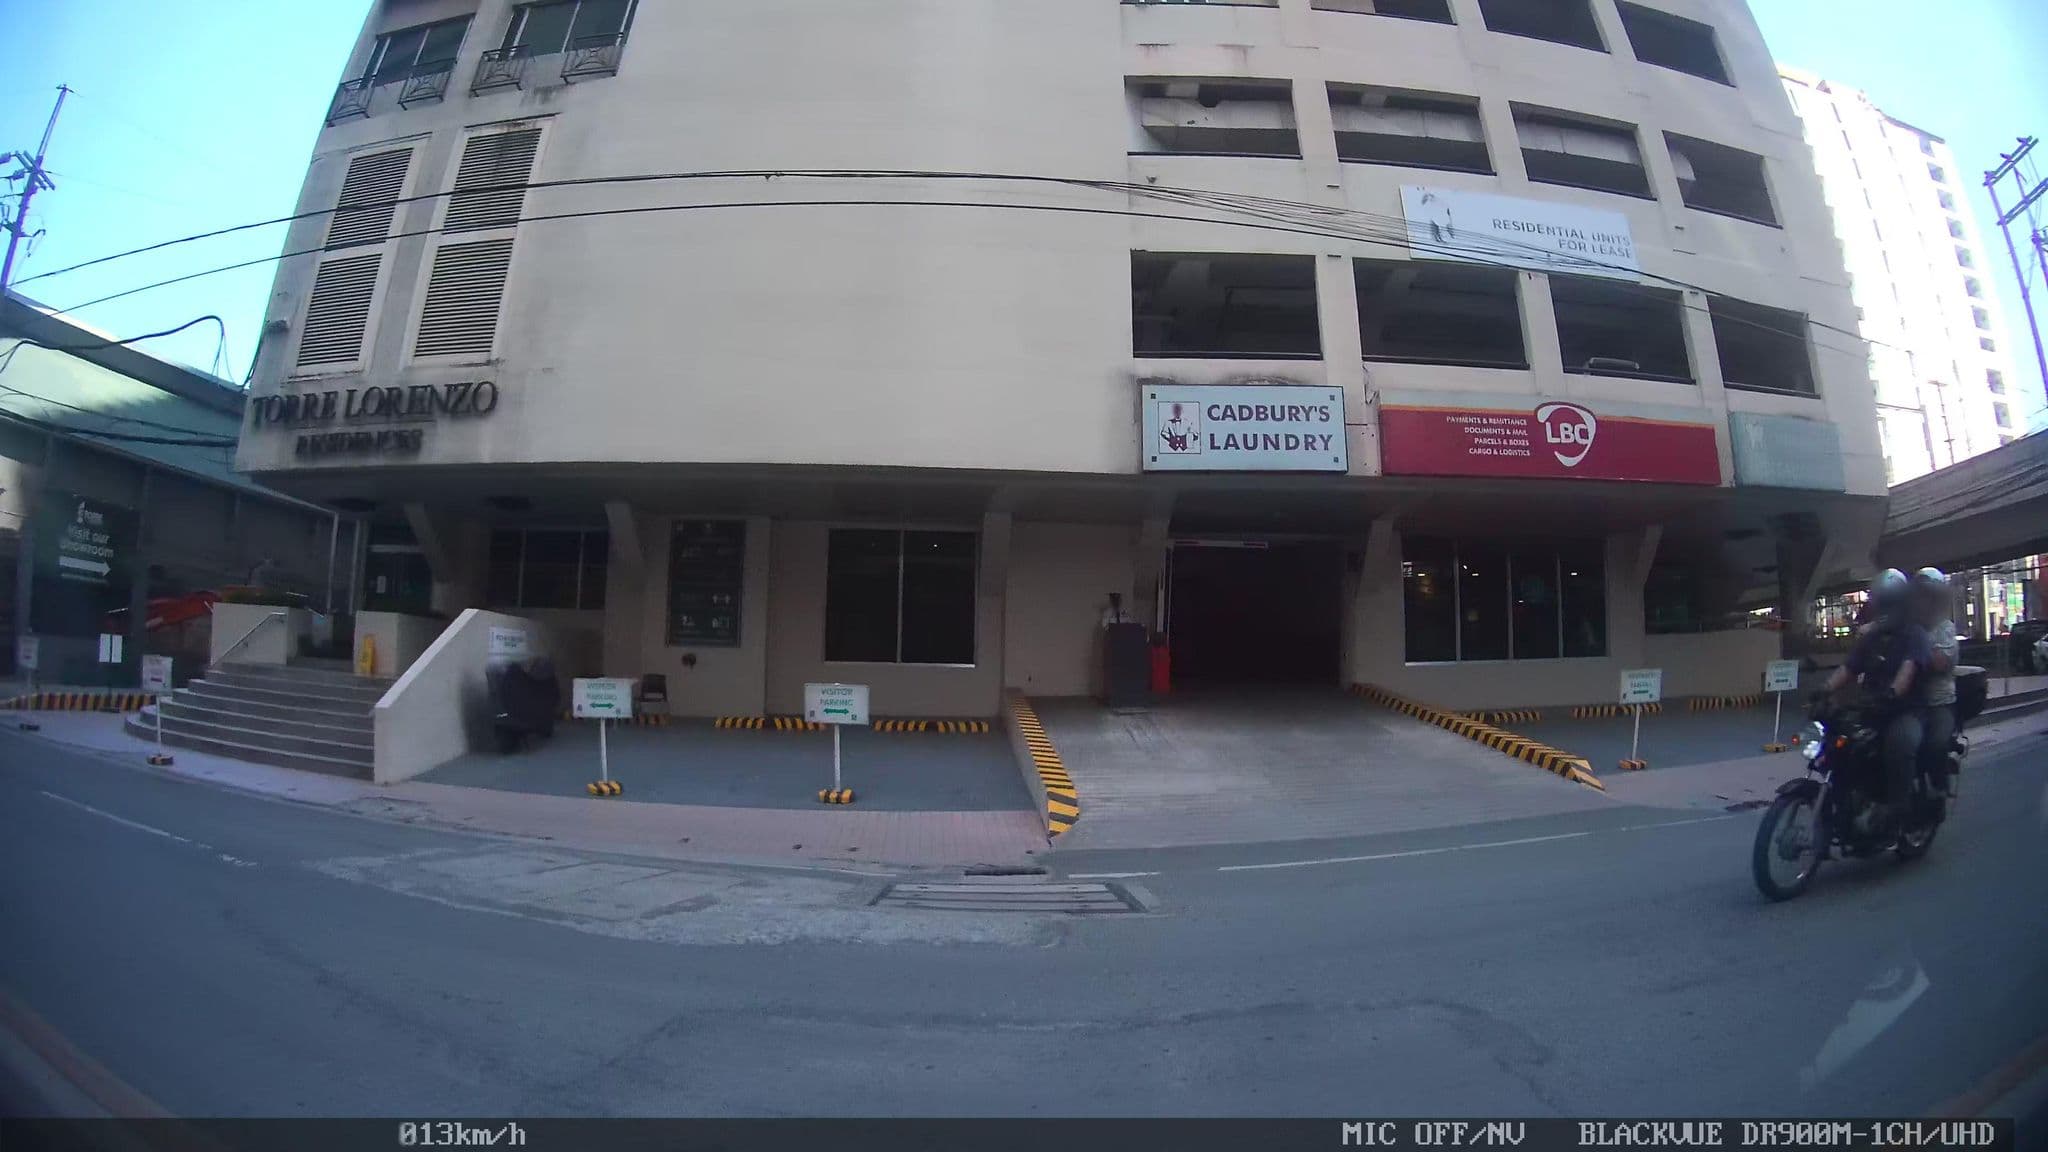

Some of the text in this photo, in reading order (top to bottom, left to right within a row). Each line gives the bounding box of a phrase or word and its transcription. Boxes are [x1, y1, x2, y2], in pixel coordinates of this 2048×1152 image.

[1492, 218, 1632, 247] RESIDENTIAL UNITS
[1558, 239, 1632, 259] FOR LEASE
[253, 380, 498, 425] TORRE LORENZO
[1207, 404, 1331, 422] CADBURY'S
[1446, 415, 1481, 424] PAYMENTS
[1488, 417, 1527, 426] REMITTANCE
[1464, 426, 1505, 435] DOCUMENTS
[1513, 428, 1528, 437] MAIL
[1545, 422, 1591, 445] LBC
[1209, 433, 1333, 451] LAUNDRY
[1474, 437, 1502, 446] PARCELS
[1509, 438, 1530, 447] BOXES
[1469, 447, 1492, 456] CARGO
[1499, 448, 1531, 457] LOGISTICS
[821, 687, 853, 696] VISITOR
